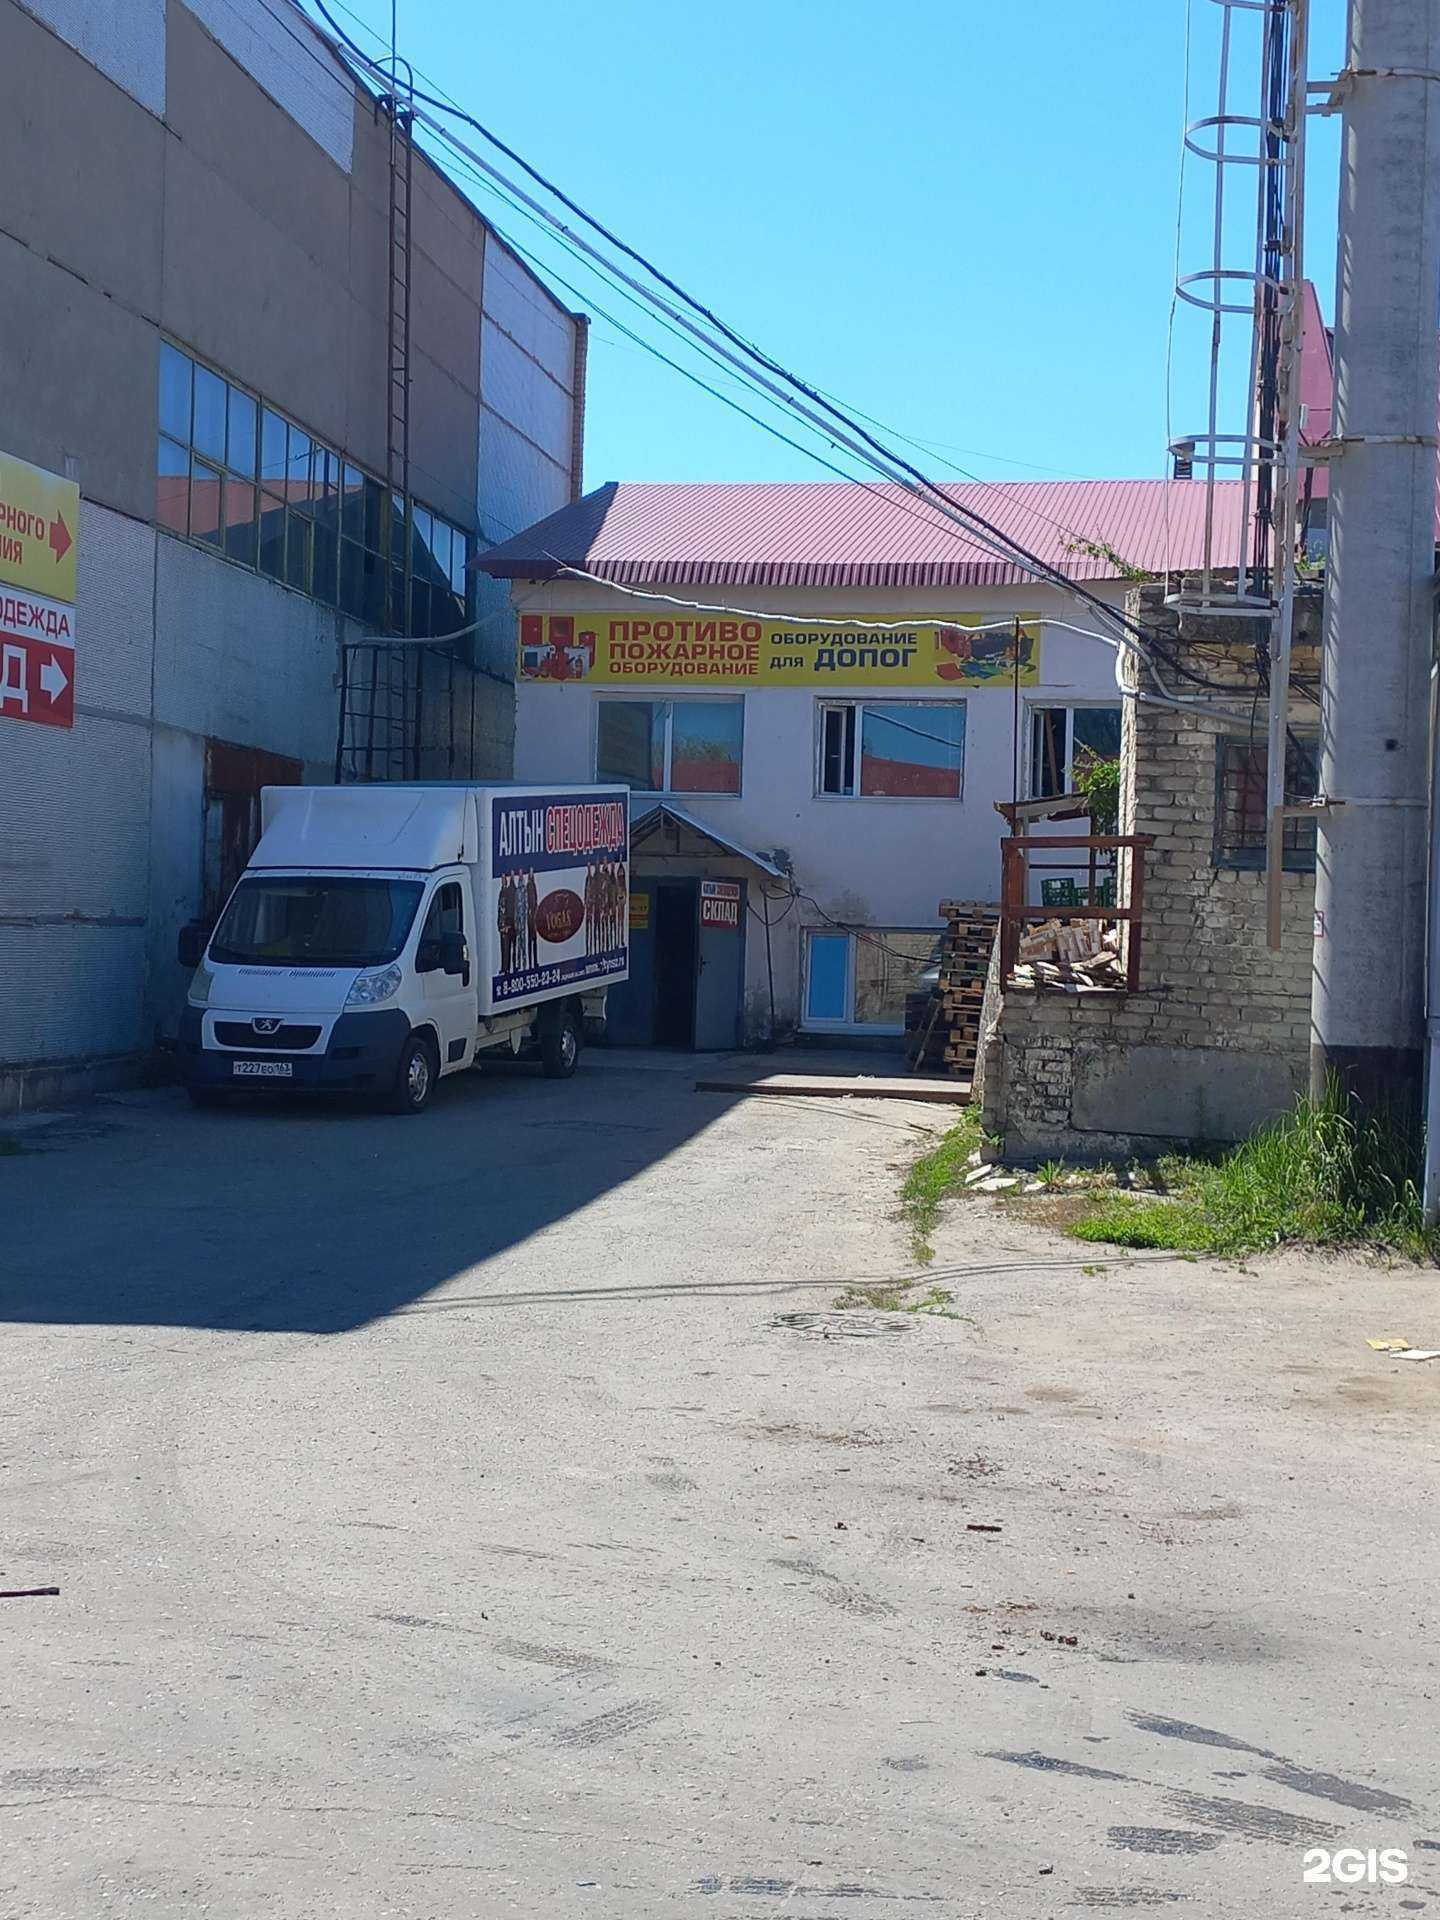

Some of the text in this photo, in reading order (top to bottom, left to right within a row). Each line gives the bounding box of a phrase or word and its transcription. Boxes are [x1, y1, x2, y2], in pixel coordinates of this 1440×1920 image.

[0, 534, 23, 564] ИЯ
[609, 620, 762, 643] ПРОТИВО
[770, 632, 917, 646] ОБОРУДОВАНИЕ
[609, 643, 760, 661] ПОЖАРНОЕ
[814, 648, 918, 671] ДОПОГ
[609, 662, 759, 677] ОБОРУДОВАНИЕ
[499, 802, 625, 856] АЛТЫН СПЕЦОДЕЖДА
[703, 899, 738, 926] СКЛАД
